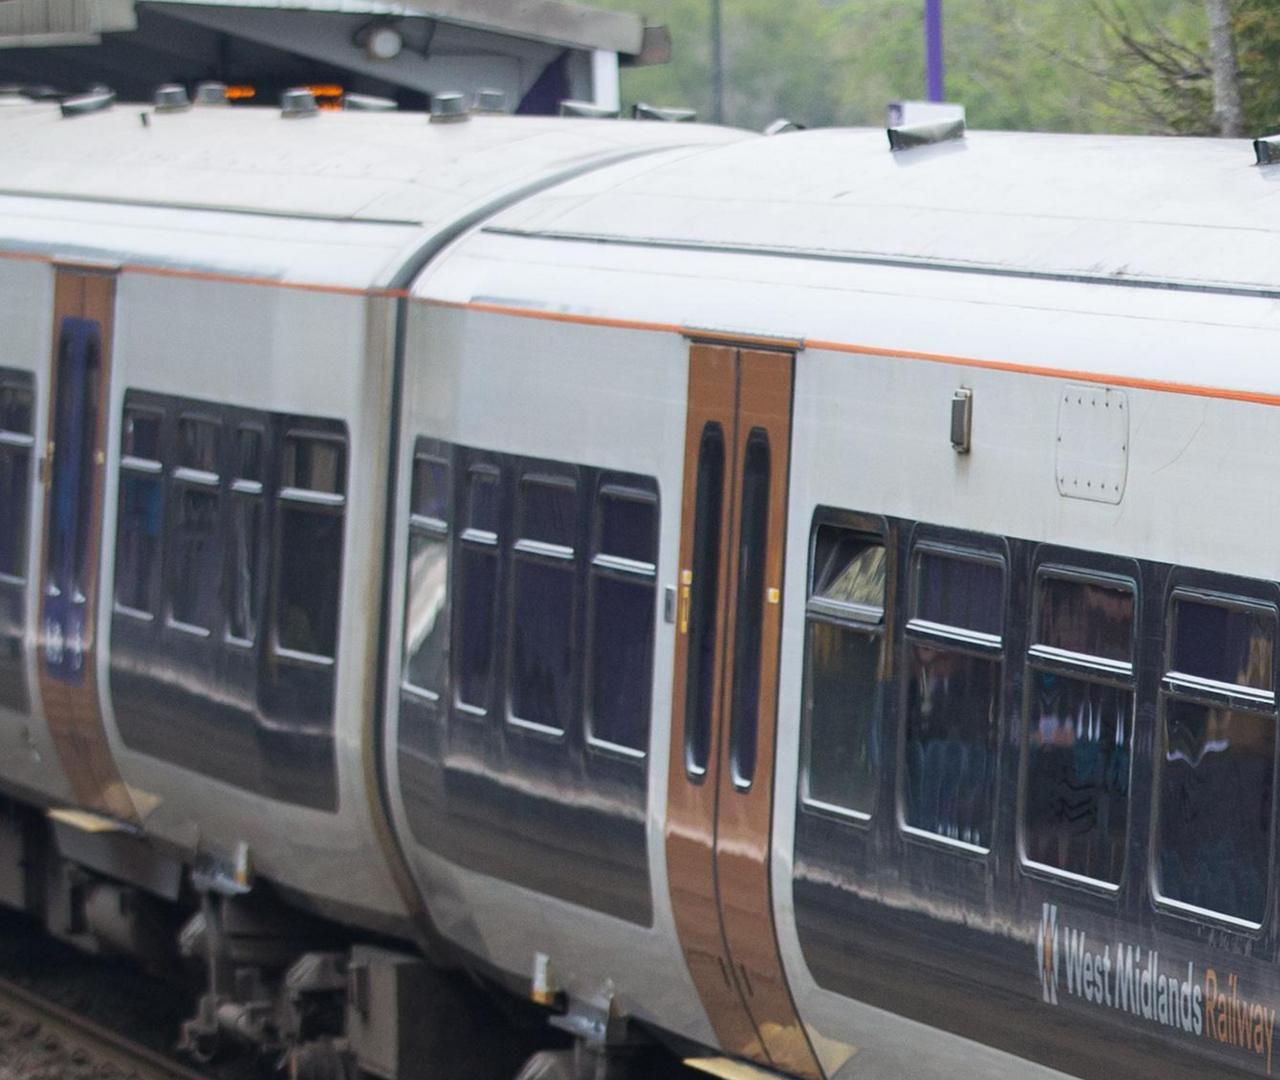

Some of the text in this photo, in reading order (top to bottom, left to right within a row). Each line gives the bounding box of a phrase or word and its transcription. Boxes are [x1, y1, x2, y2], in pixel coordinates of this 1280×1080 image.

[1064, 926, 1276, 1076] West Midlands Railway
